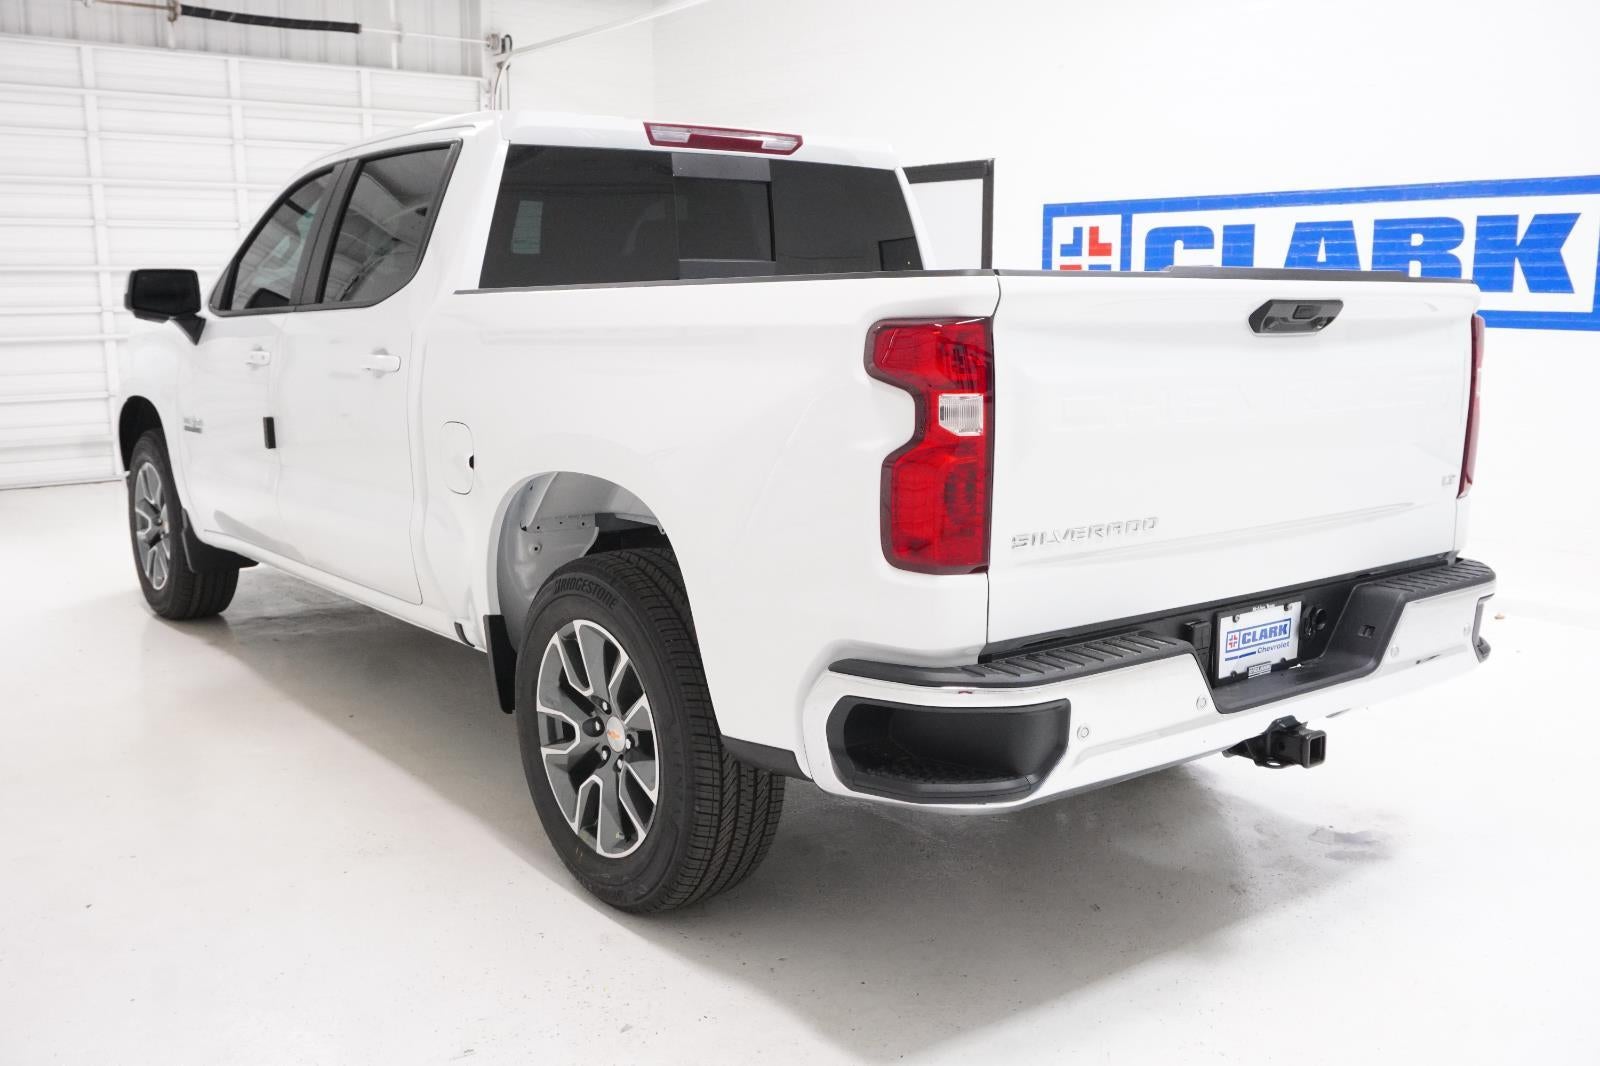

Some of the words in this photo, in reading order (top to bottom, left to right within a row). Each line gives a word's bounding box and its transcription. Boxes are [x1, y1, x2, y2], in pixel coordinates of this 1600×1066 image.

[1144, 212, 1582, 294] CLARK
[1010, 516, 1160, 549] SILVERADO
[553, 576, 618, 609] BRIDGESTONE
[1241, 623, 1289, 645] CLARK
[1257, 641, 1290, 654] Chevrolet
